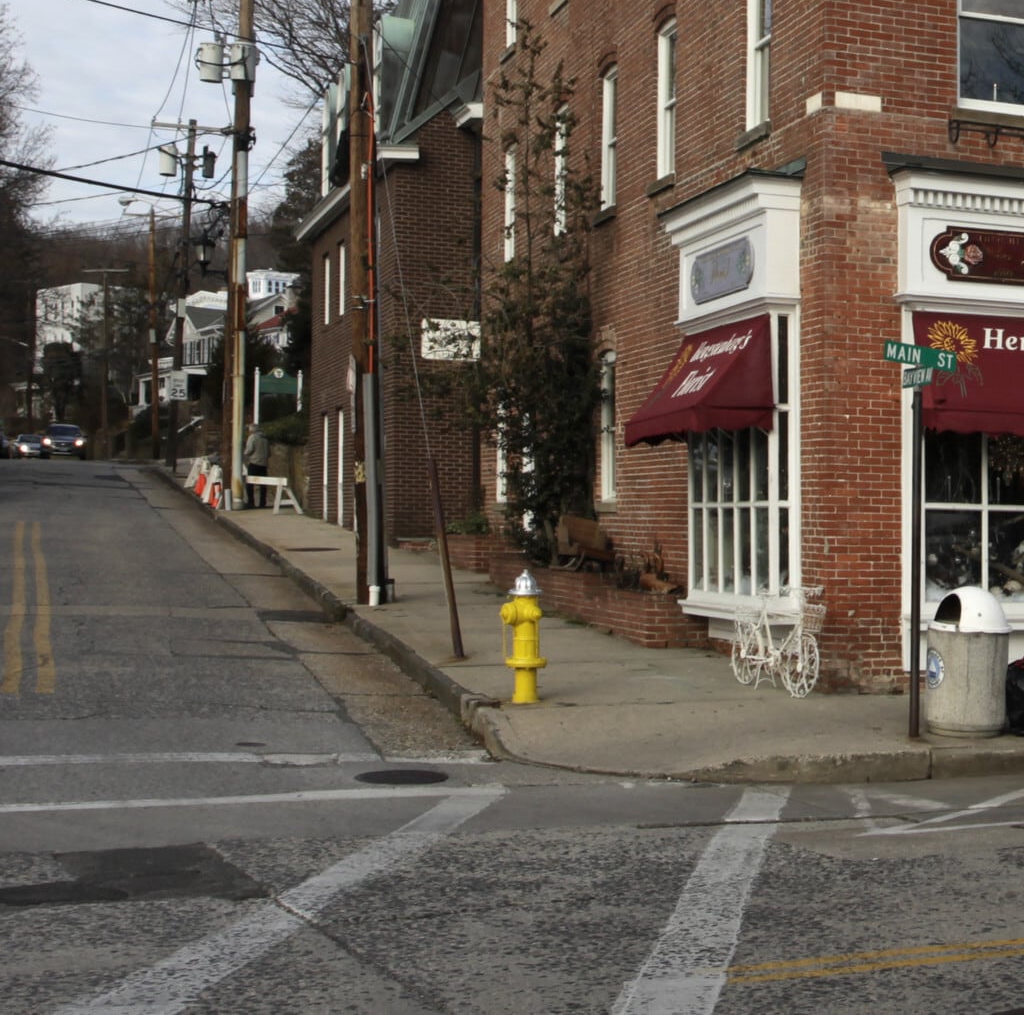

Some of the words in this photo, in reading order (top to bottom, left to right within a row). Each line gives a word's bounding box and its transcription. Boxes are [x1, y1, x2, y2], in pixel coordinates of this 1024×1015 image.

[886, 343, 921, 363] MAIN
[937, 352, 954, 369] ST
[171, 388, 186, 398] 25
[671, 367, 717, 399] Florist
